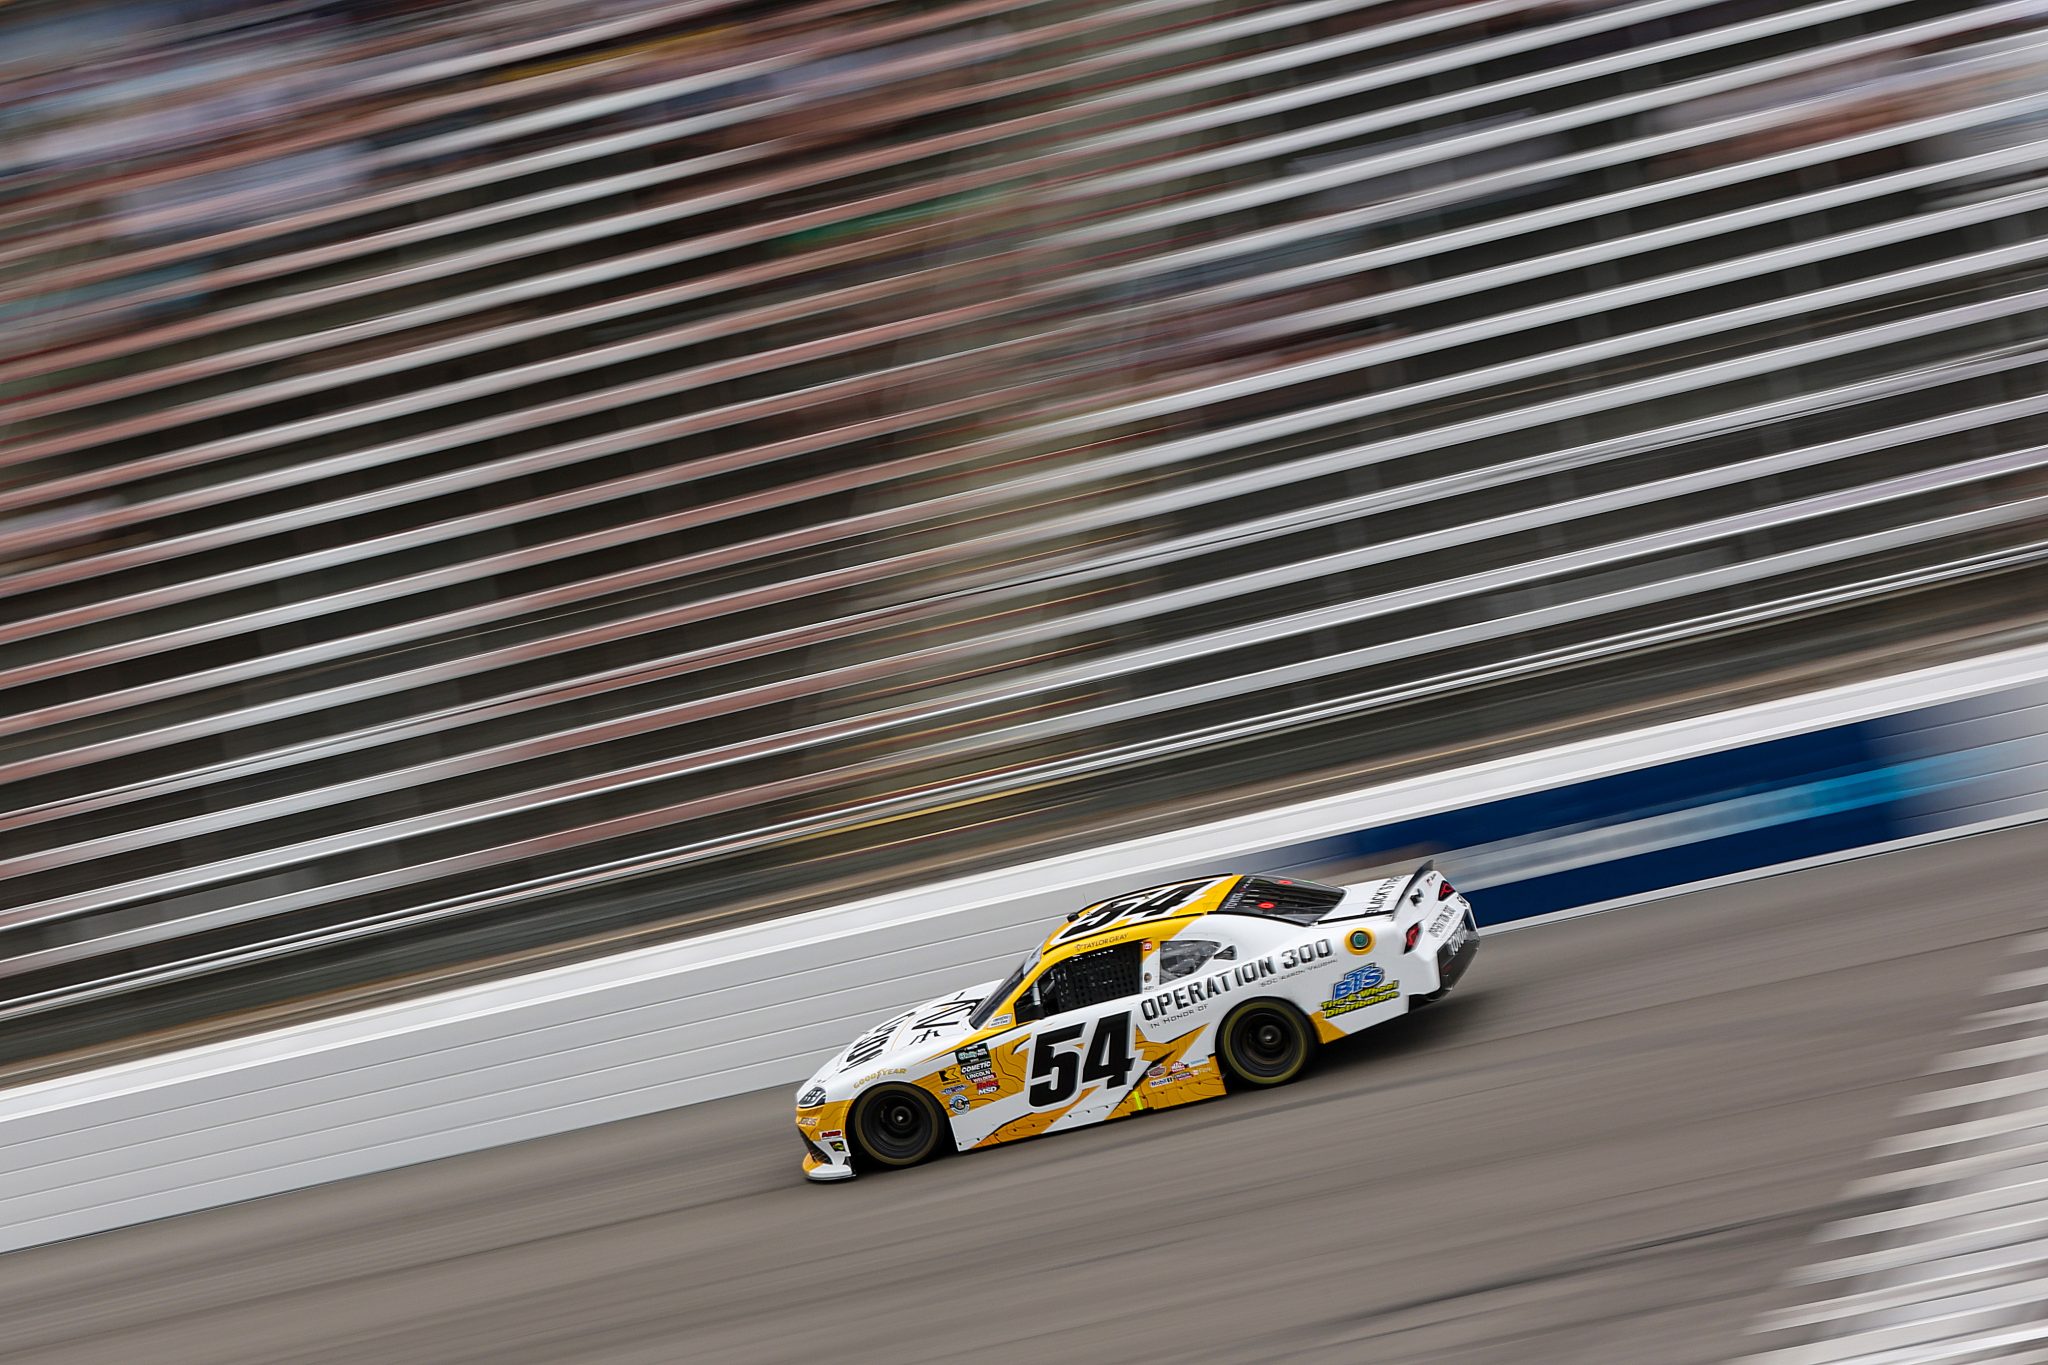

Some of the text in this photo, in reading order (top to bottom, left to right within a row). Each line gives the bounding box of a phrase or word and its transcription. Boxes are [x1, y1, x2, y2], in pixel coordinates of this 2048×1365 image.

[1084, 938, 1108, 949] TAYLOR
[1140, 938, 1334, 1022] OPERATION 300
[1332, 962, 1385, 1000] BTS
[1150, 1003, 1209, 1029] IN HONOR OF
[961, 1061, 991, 1074] COMETIC
[1028, 1010, 1137, 1108] 54
[853, 1066, 908, 1090] GOODYEAR
[966, 1069, 991, 1080] LINCOLN
[978, 1086, 998, 1095] MSD
